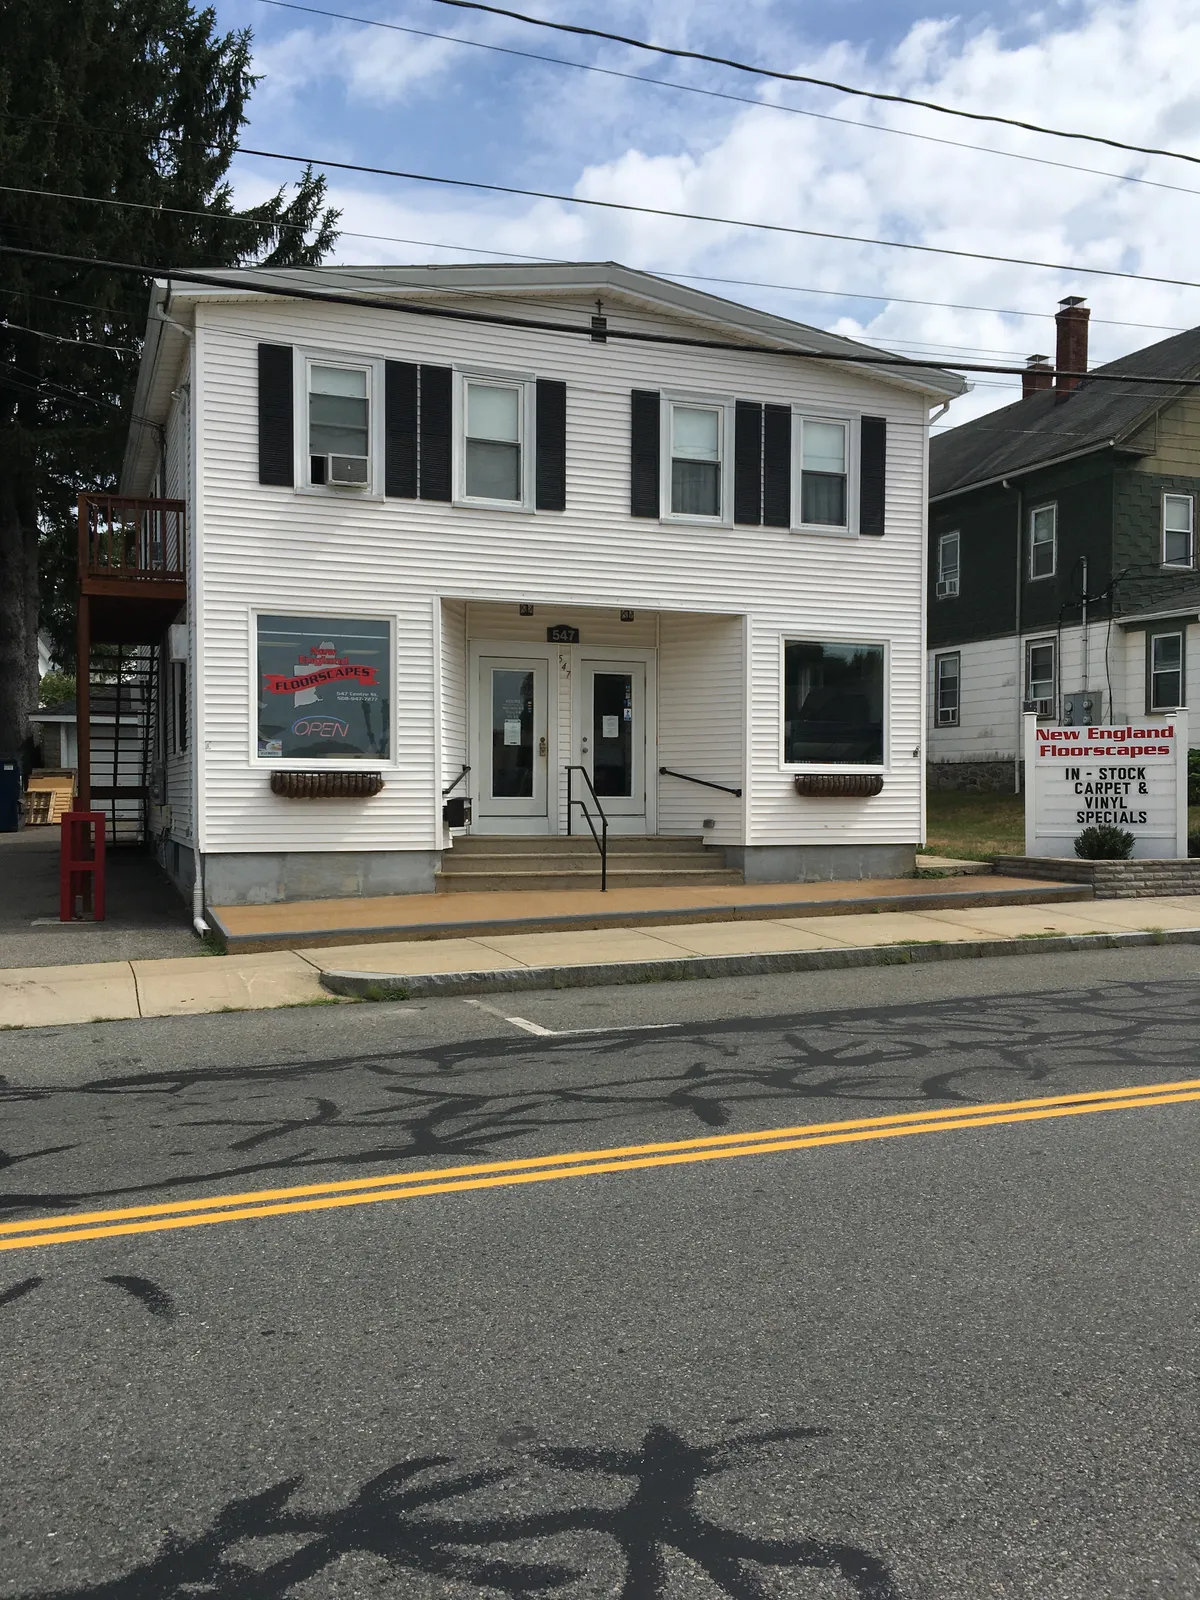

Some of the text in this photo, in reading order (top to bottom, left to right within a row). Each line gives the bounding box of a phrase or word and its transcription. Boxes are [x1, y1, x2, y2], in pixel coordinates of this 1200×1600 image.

[552, 629, 575, 641] 547
[299, 656, 349, 666] England
[275, 667, 370, 691] FLOORSCAPES
[293, 721, 349, 737] OPEN
[1036, 726, 1174, 742] New England
[1040, 745, 1170, 758] Floorscapes
[1065, 768, 1080, 780] IN
[1099, 767, 1146, 780] STOCK
[1075, 782, 1149, 795] CARPET &
[1085, 796, 1128, 809] VINYL
[1077, 811, 1147, 824] SPECIALS
